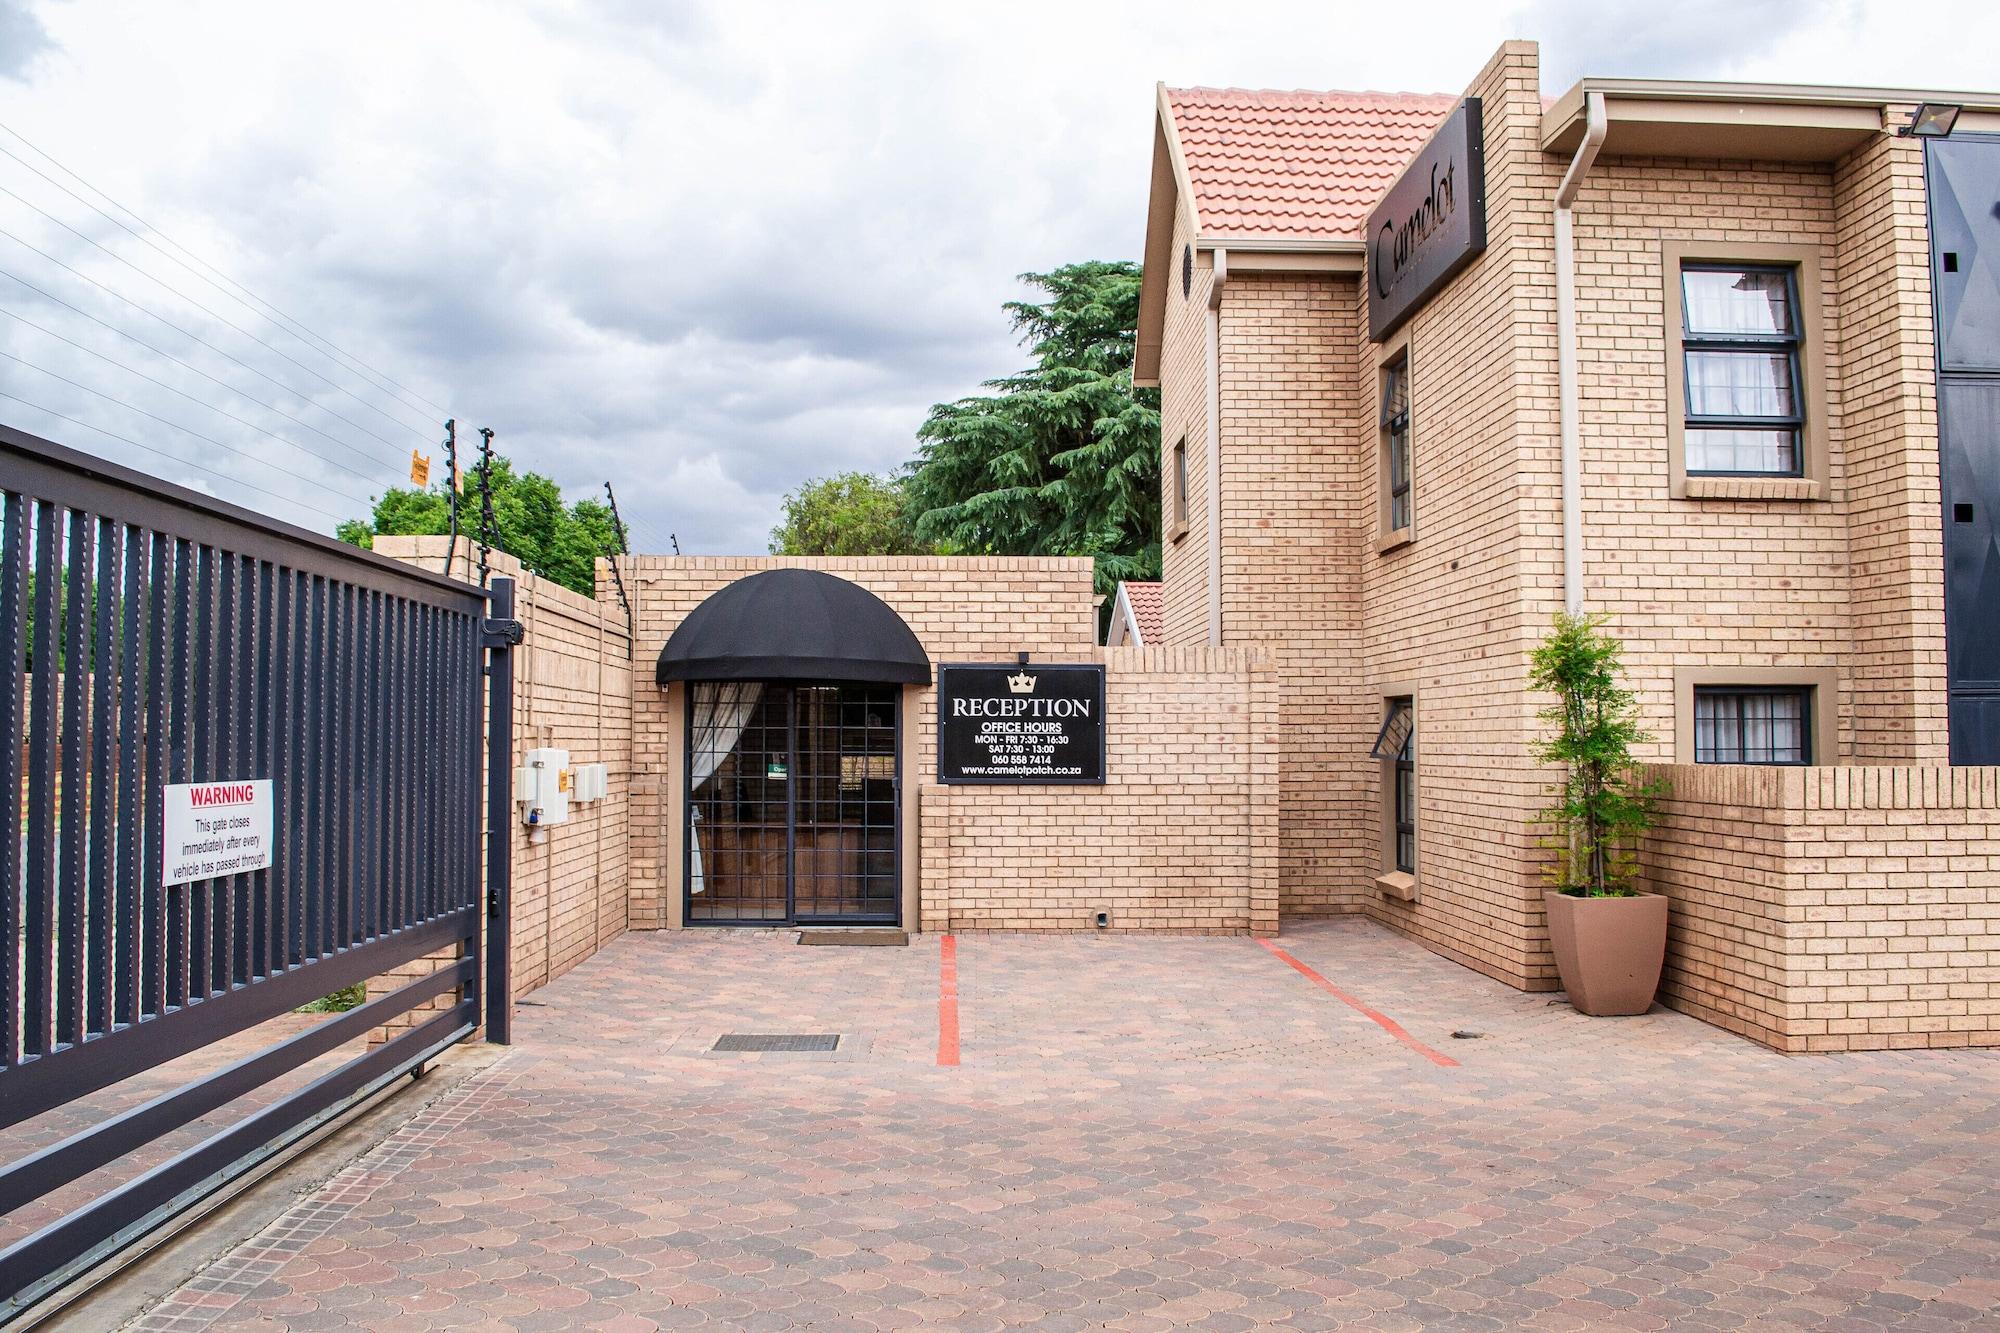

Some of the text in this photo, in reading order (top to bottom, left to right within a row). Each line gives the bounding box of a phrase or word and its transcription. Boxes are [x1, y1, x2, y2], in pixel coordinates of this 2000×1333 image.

[1376, 155, 1456, 299] Camelot
[953, 698, 1090, 717] RECEPTION
[981, 722, 1062, 734] OFFICE HOURS
[974, 735, 997, 744] MON
[1006, 735, 1018, 744] FRI
[1020, 735, 1038, 744] 7:30
[1047, 735, 1069, 744] 16:30
[988, 745, 1004, 754] SAT
[1006, 745, 1024, 754] 7:30
[1032, 745, 1055, 754] 13:00
[991, 755, 1051, 764] 060 558 7414
[961, 765, 1082, 776] www.camelotpotch.co.za
[191, 785, 254, 806] WARNING
[195, 816, 250, 834] This gate closes
[182, 835, 260, 856] immediately after every
[173, 851, 266, 879] vehicle has passed through
